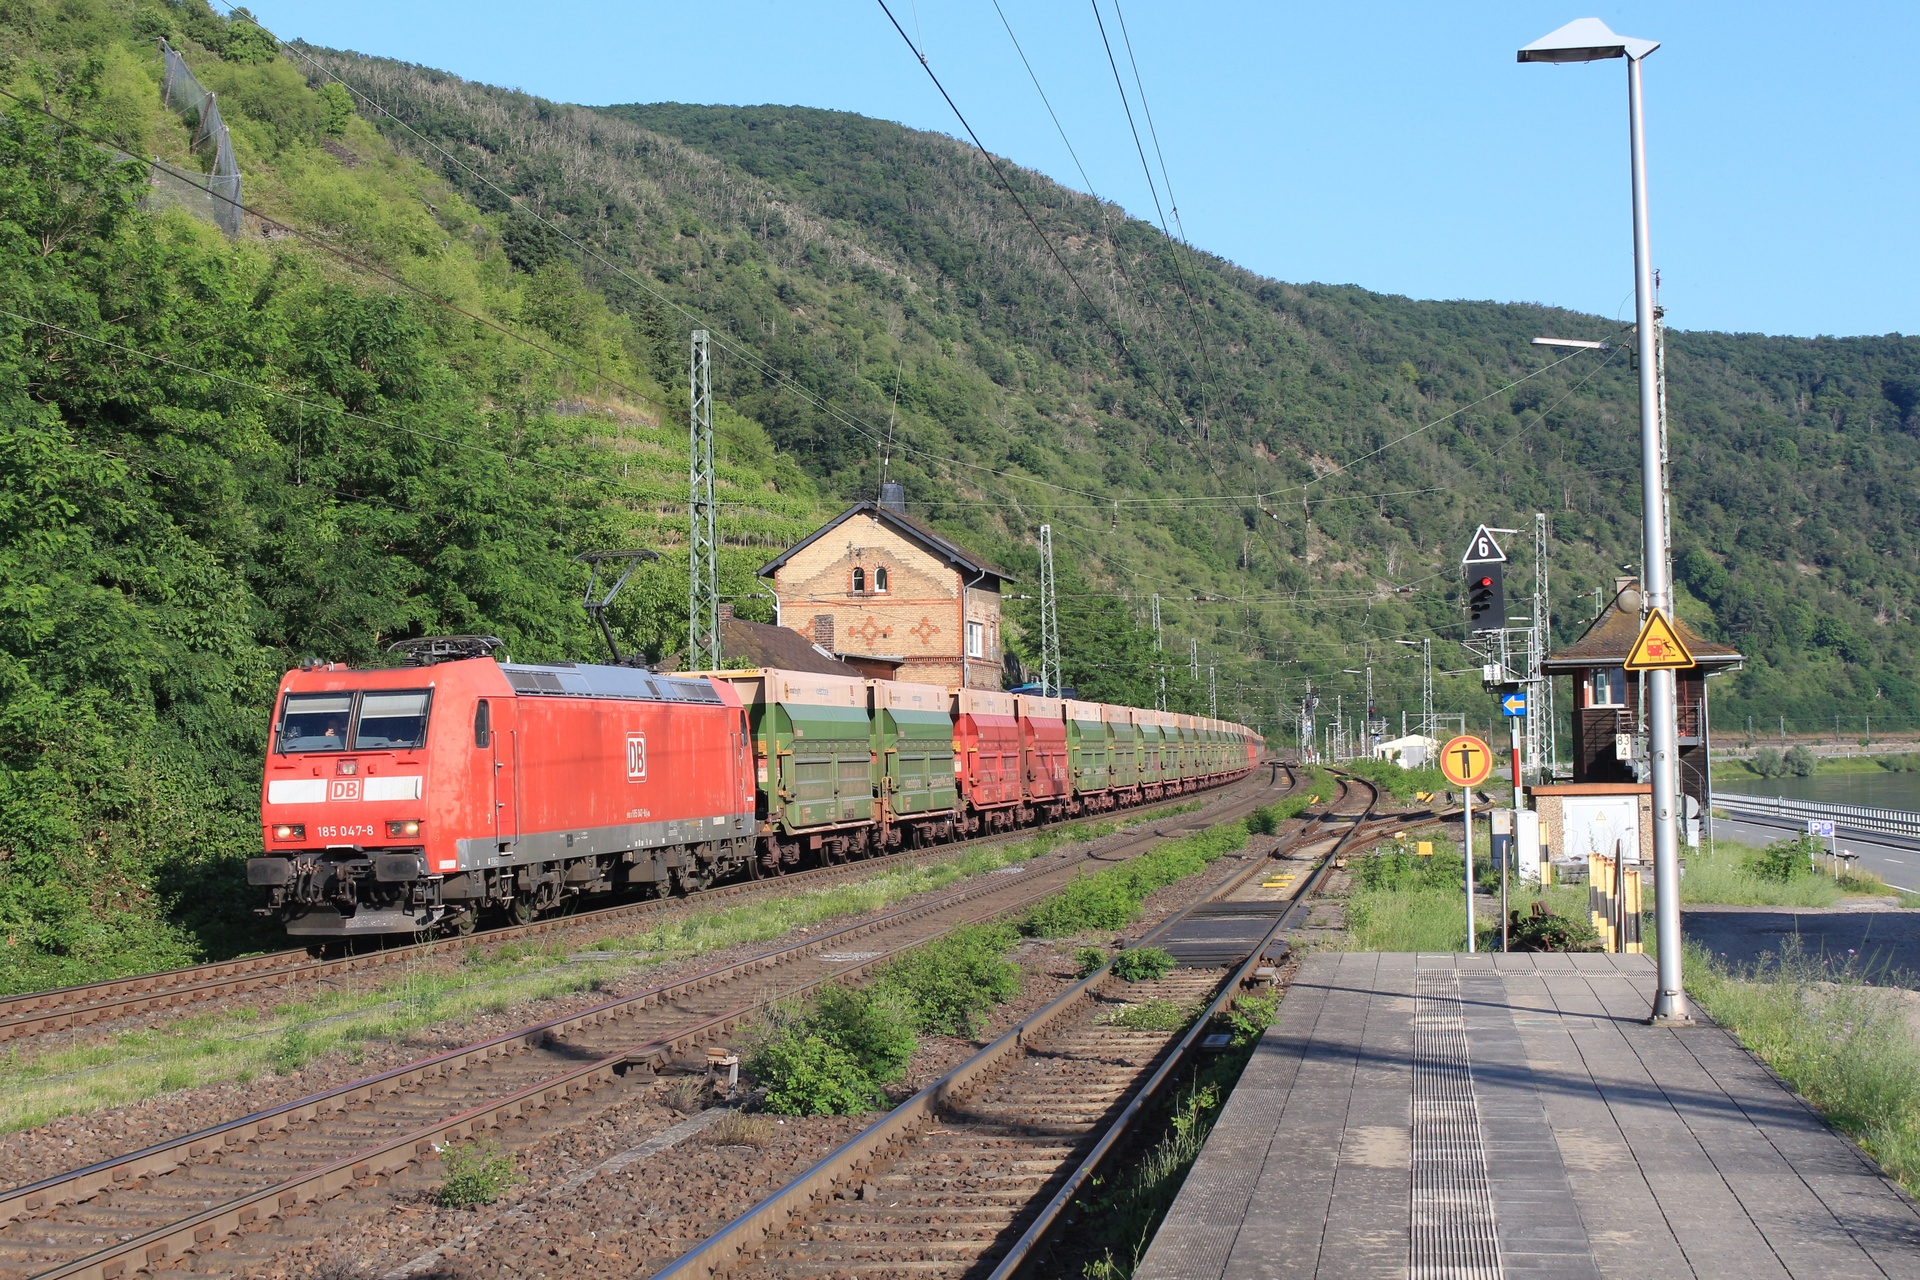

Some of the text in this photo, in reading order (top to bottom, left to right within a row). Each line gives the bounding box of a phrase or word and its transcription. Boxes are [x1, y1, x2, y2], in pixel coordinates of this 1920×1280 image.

[1478, 537, 1489, 557] 6
[1617, 735, 1630, 746] 83
[629, 741, 644, 773] DB
[1620, 746, 1628, 756] 4
[333, 782, 357, 798] DB
[317, 825, 374, 837] 185 047-8
[1811, 822, 1821, 834] P
